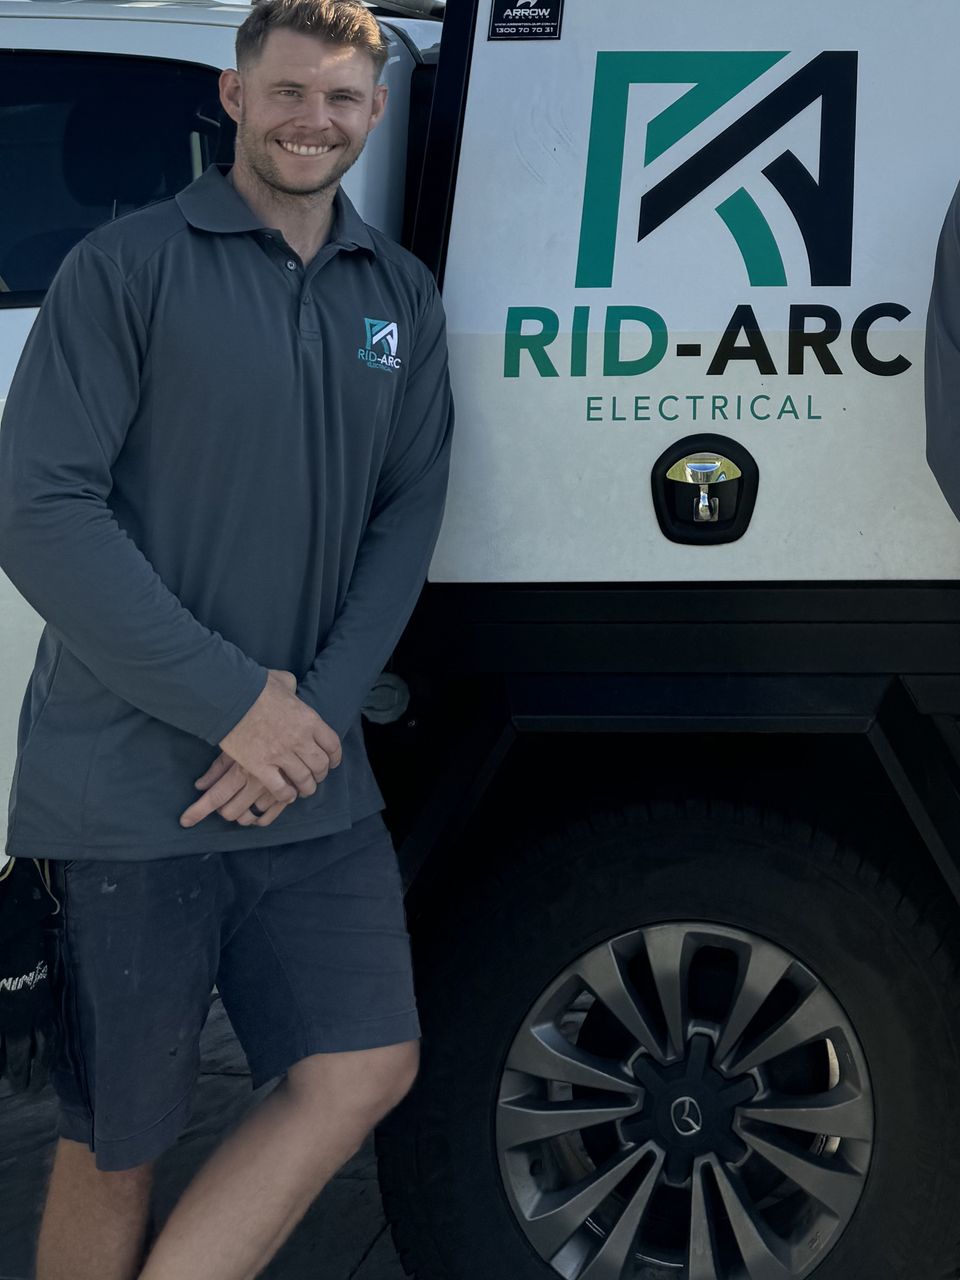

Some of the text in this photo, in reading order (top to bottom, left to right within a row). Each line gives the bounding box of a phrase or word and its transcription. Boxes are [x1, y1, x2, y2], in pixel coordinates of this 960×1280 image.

[503, 8, 551, 17] ARROW
[503, 302, 913, 378] RID-ARC
[358, 348, 402, 369] RID-ARC
[586, 395, 822, 421] ELECTRICAL
